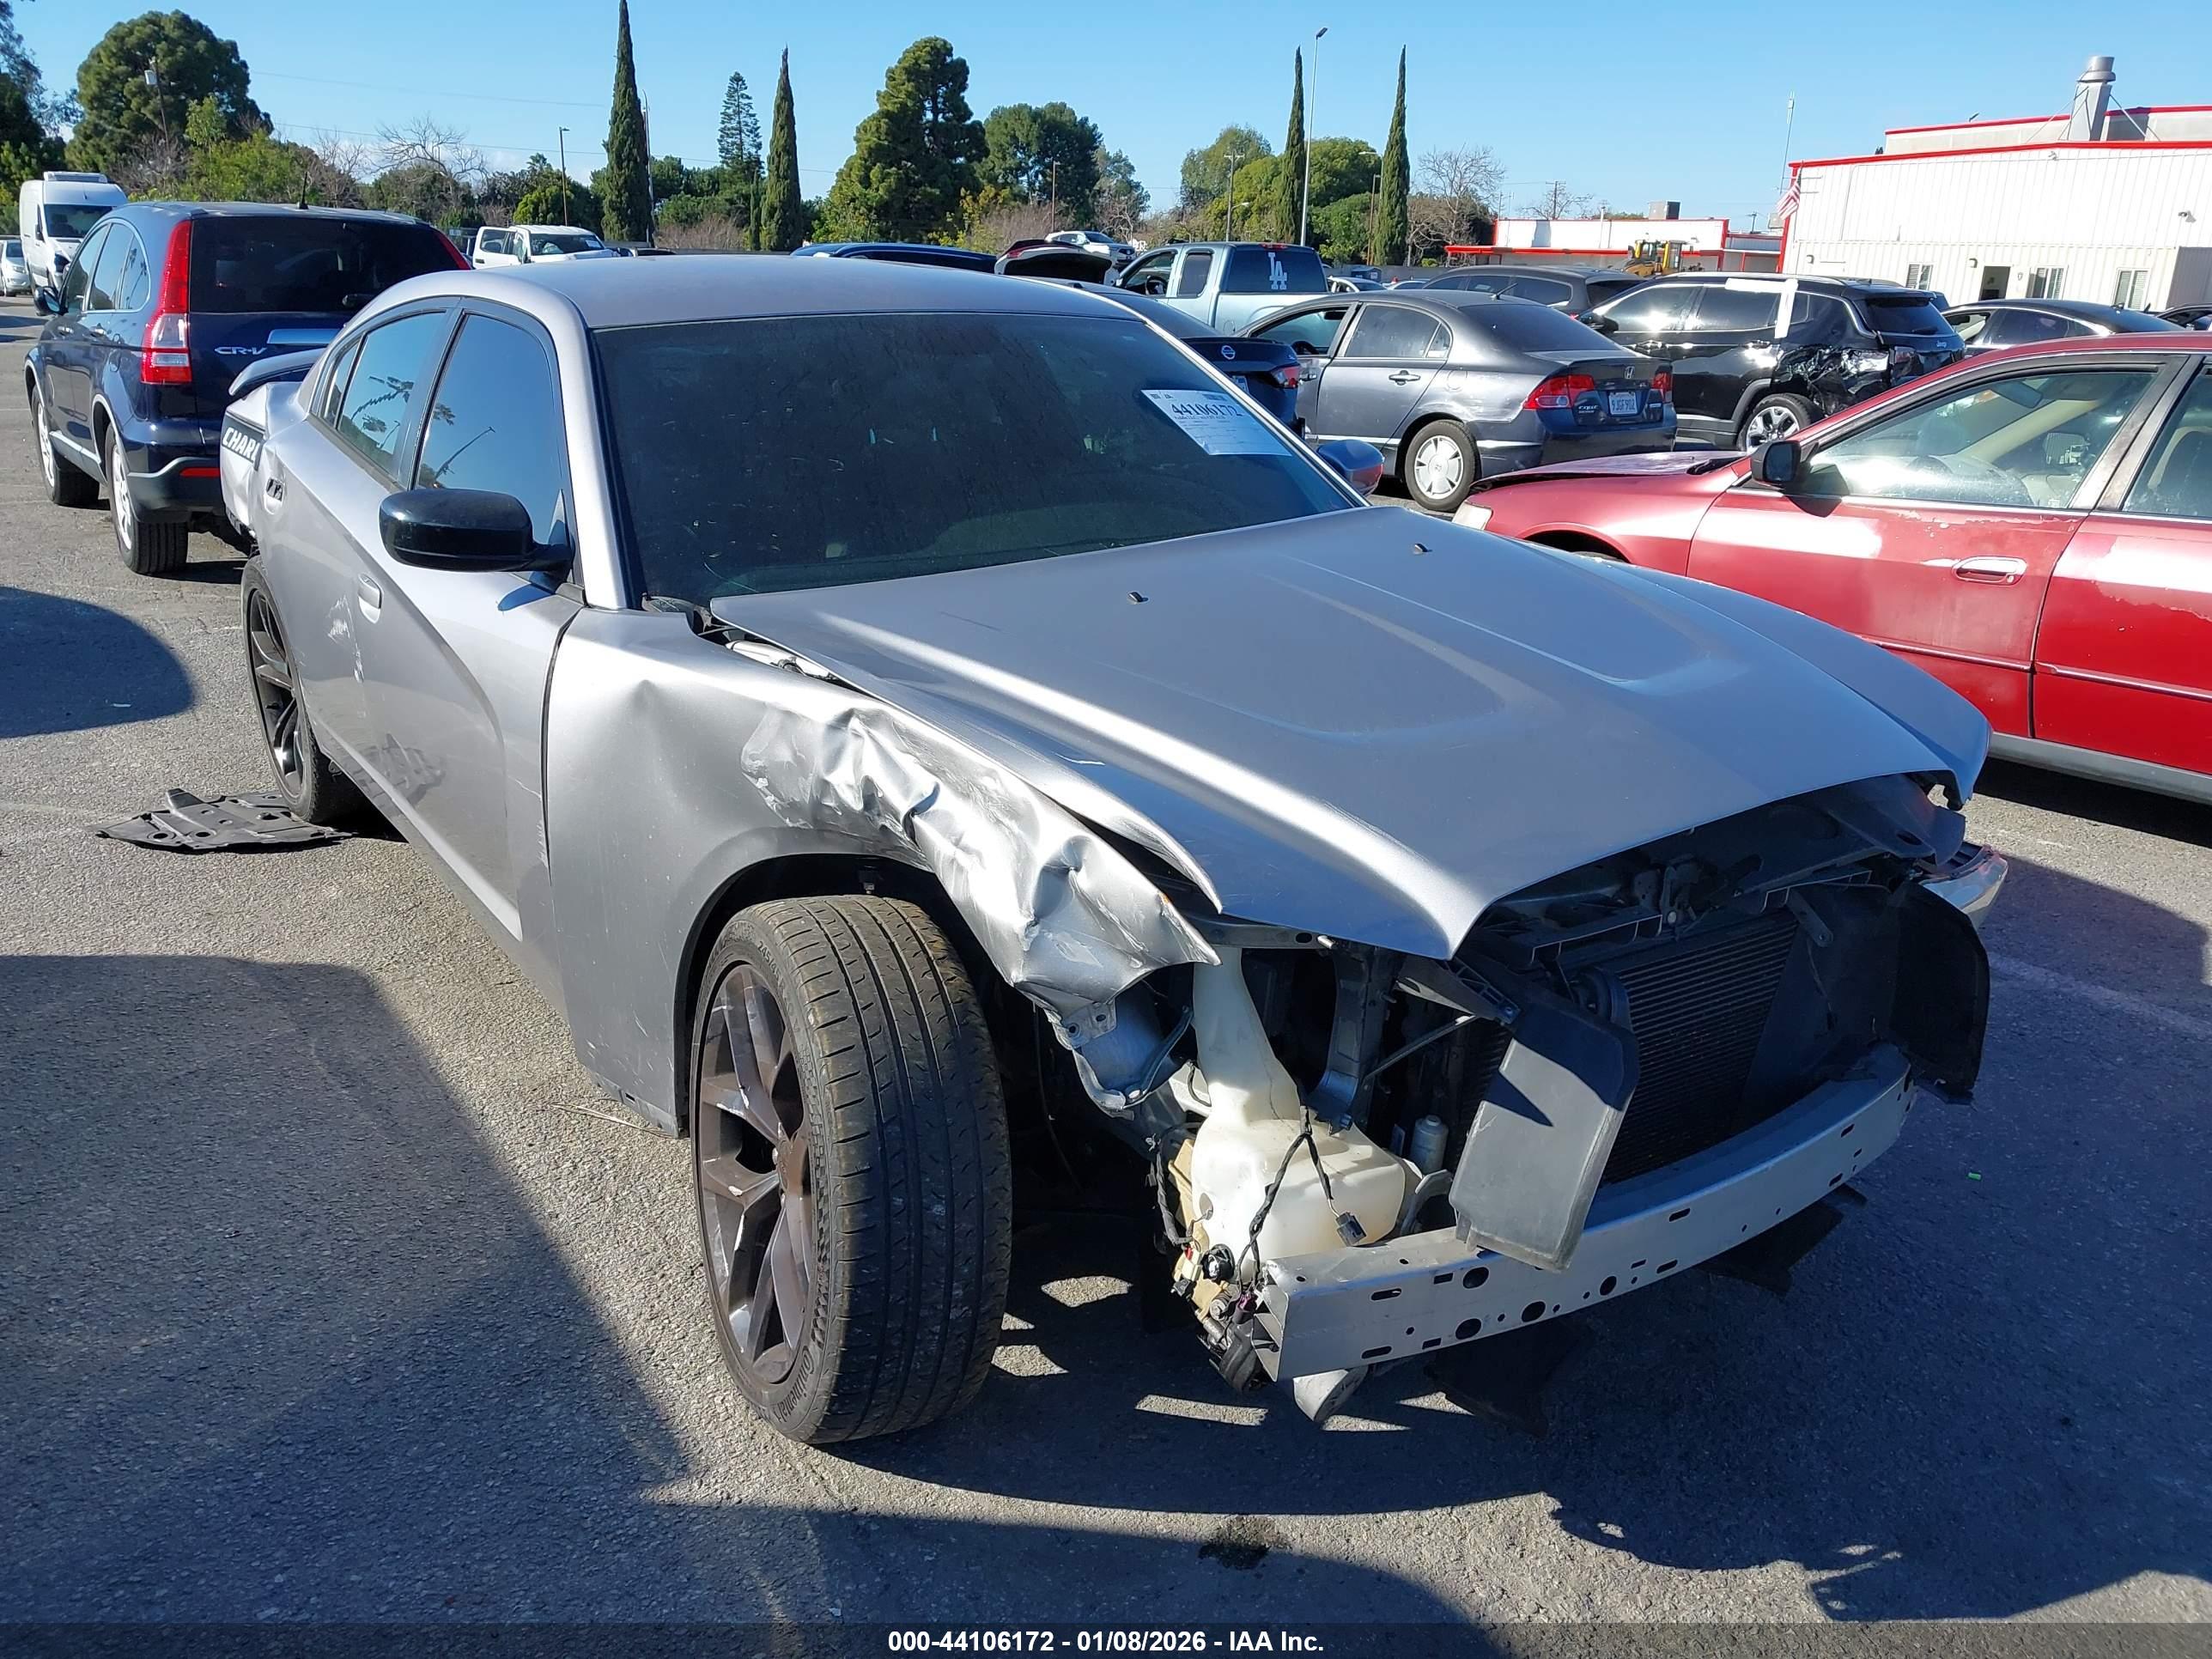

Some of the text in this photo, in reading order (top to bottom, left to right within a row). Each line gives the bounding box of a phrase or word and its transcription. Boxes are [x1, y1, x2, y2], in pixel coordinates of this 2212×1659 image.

[1268, 252, 1287, 289] LA
[215, 346, 267, 355] CR-V
[1170, 403, 1243, 416] 44106172
